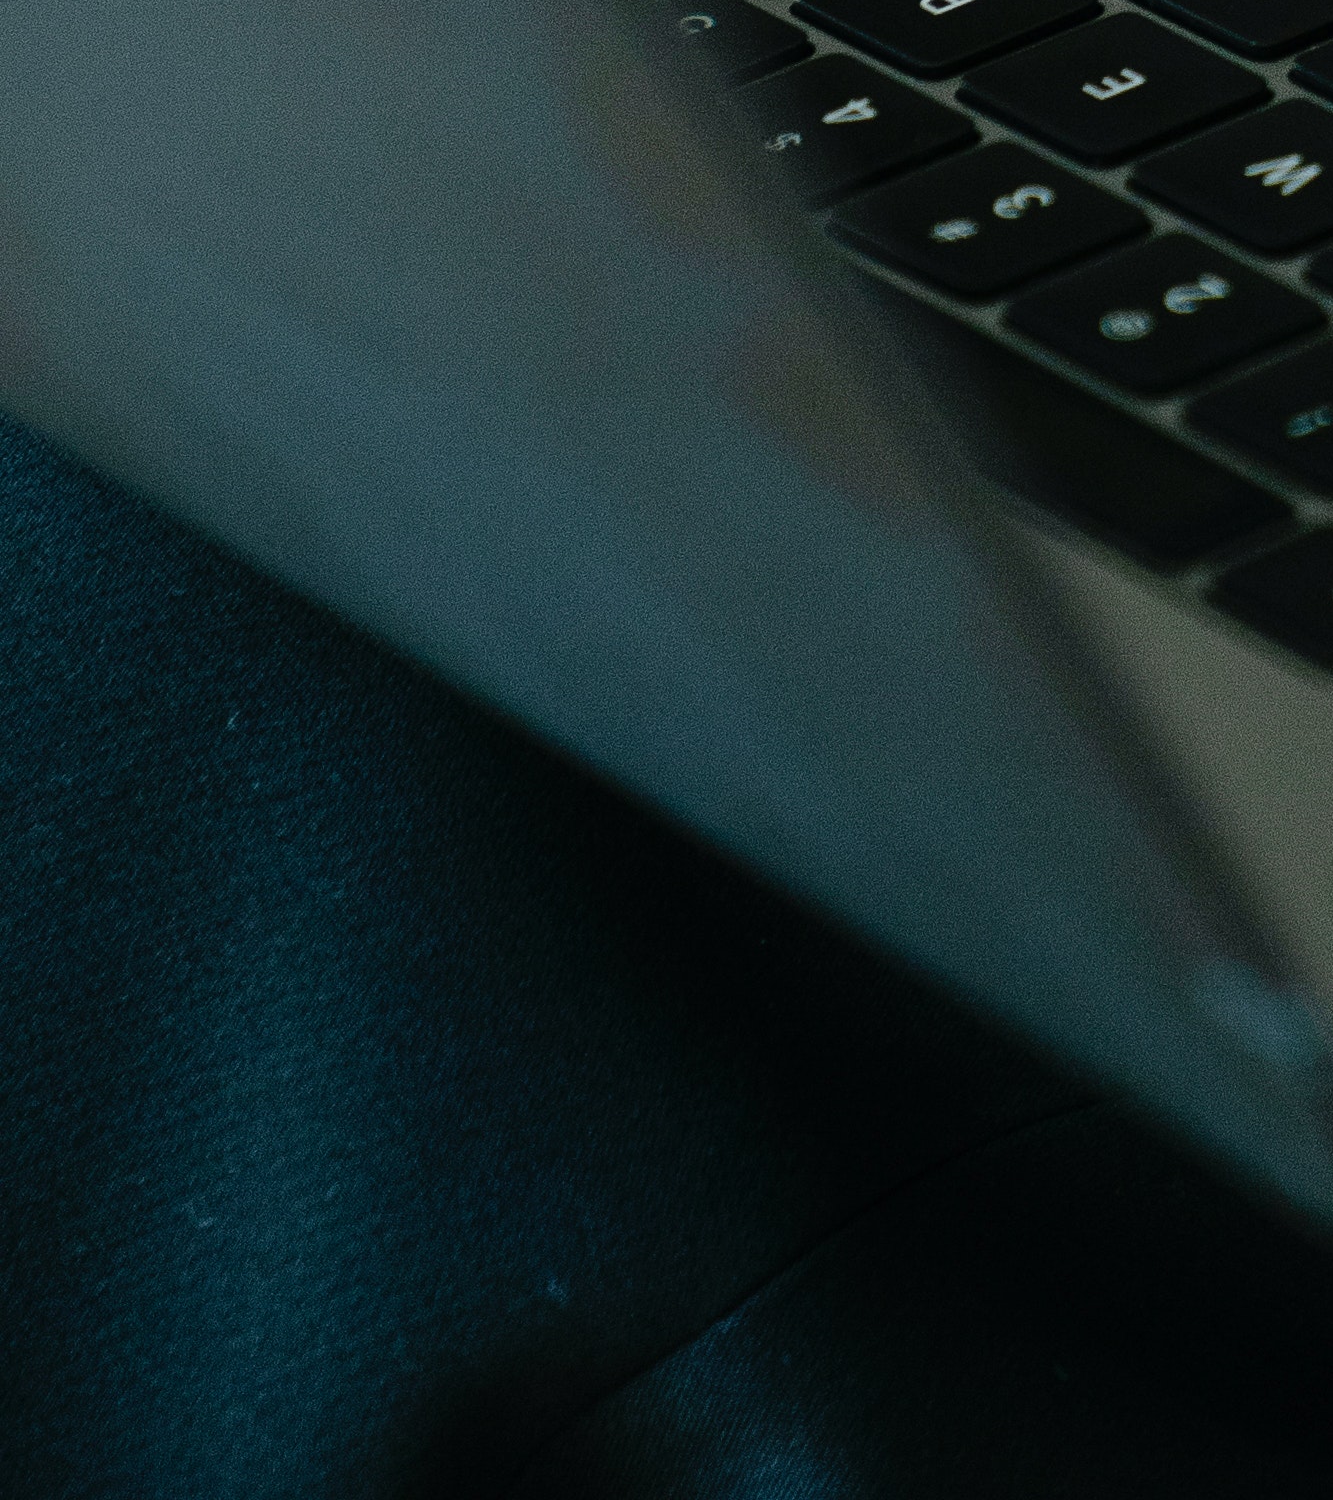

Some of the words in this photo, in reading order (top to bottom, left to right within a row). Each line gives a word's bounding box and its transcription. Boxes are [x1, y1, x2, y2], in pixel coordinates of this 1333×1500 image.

[1081, 67, 1147, 102] E
[821, 96, 878, 126] 4
[1243, 152, 1322, 196] W
[991, 184, 1055, 220] 3
[1162, 273, 1230, 316] 2
